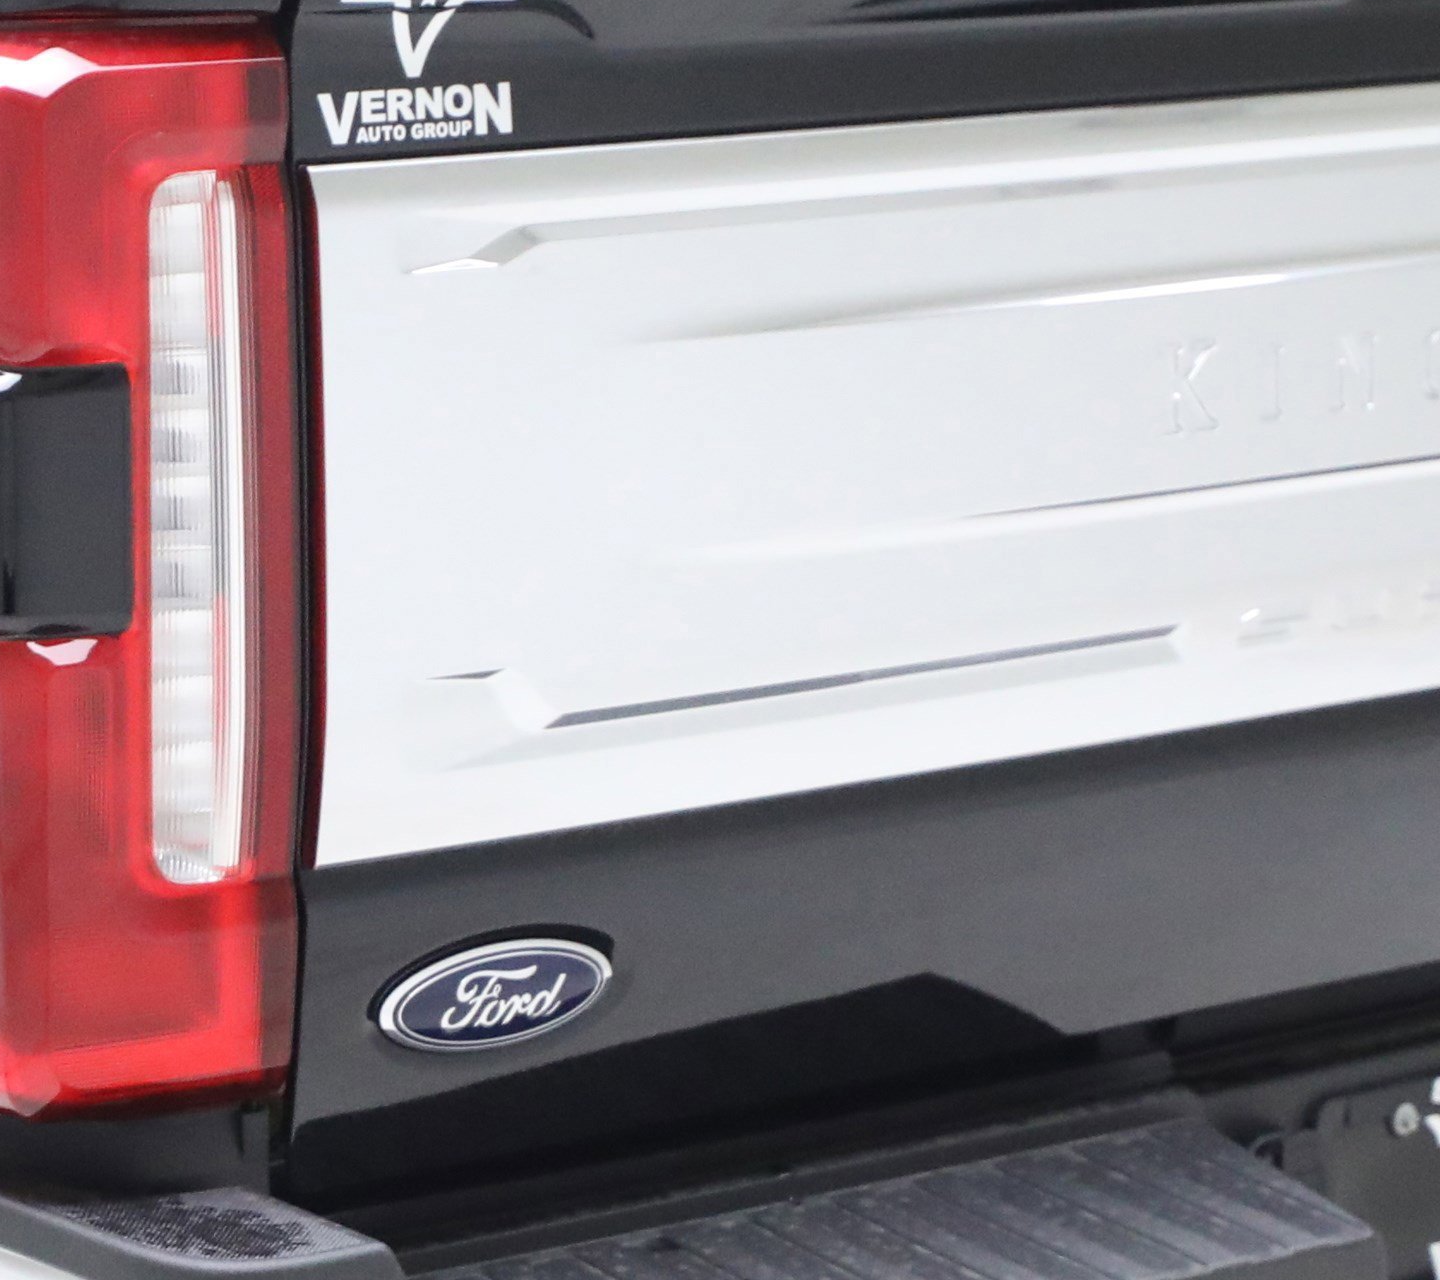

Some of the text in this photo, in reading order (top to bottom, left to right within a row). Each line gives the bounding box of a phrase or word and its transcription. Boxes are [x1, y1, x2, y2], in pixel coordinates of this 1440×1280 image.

[317, 82, 513, 146] VERNON
[355, 120, 473, 144] AUTO GROUP
[440, 965, 567, 1030] Ford
